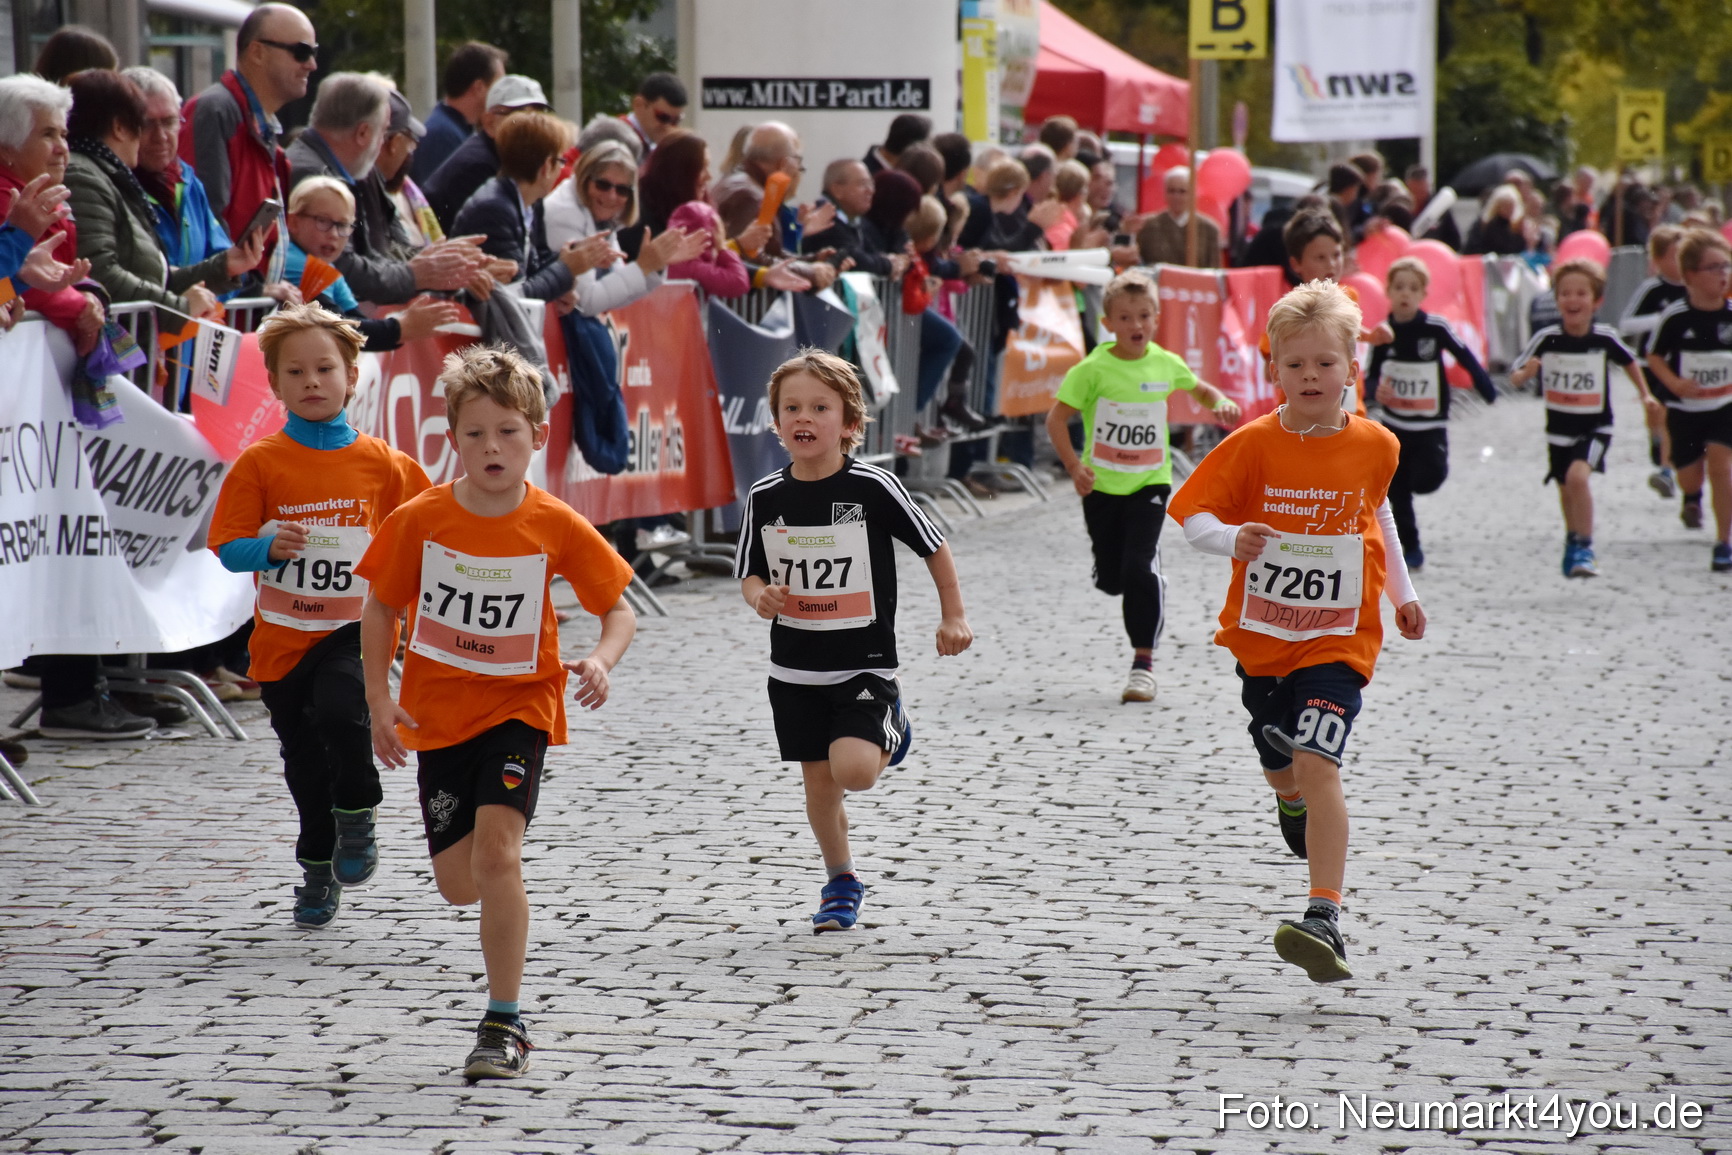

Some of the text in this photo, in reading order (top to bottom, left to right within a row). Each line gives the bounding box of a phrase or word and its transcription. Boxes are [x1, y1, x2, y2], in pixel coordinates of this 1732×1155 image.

[1212, 0, 1246, 32] B
[703, 81, 914, 108] www.MINI-Partl.de
[1629, 110, 1651, 144] C
[1551, 371, 1594, 390] 7126
[1105, 421, 1157, 446] 7066
[277, 498, 356, 515] Neumarkter
[798, 535, 836, 545] BOCK
[1292, 543, 1334, 555] BOCK
[275, 557, 353, 592] 7195
[467, 566, 512, 579] BOCK
[779, 556, 853, 590] 7127
[1263, 562, 1342, 601] 7261
[292, 599, 324, 613] Alwin
[422, 604, 431, 613] B4
[437, 581, 525, 630] 7157
[798, 600, 838, 613] Samuel
[1260, 600, 1341, 629] DAVID
[455, 635, 495, 655] Lukas
[1306, 698, 1346, 717] RACING
[1293, 707, 1346, 753] 90
